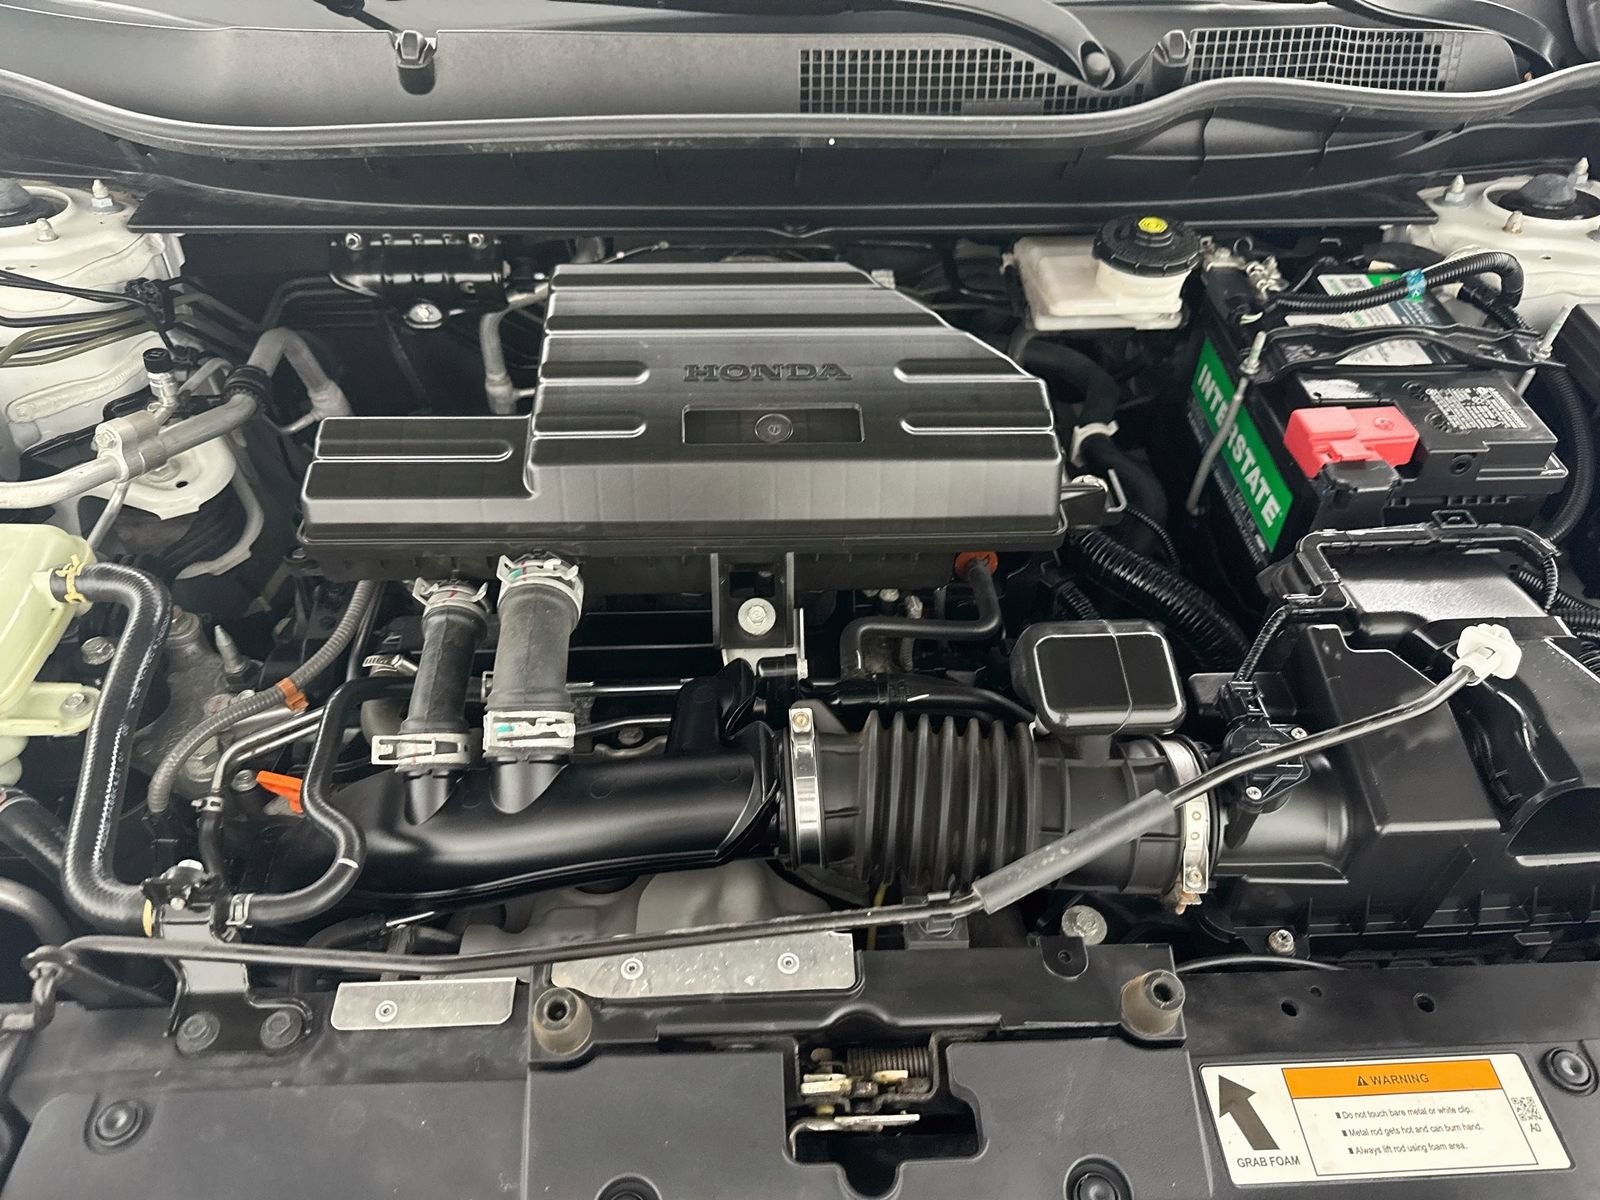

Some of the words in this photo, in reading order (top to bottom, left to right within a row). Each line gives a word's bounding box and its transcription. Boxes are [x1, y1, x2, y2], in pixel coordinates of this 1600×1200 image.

[684, 363, 852, 382] HONDA
[1197, 365, 1281, 528] INTERSTATE
[1370, 1073, 1429, 1085] WARNING
[1342, 1111, 1353, 1119] Do
[1367, 1110, 1388, 1118] touch
[1390, 1108, 1406, 1117] bare
[1407, 1108, 1427, 1116] metal
[1437, 1106, 1456, 1114] white
[1349, 1128, 1369, 1137] Metal
[1371, 1128, 1382, 1136] rod
[1384, 1126, 1400, 1137] gets
[1402, 1126, 1413, 1134] hot
[1415, 1125, 1428, 1133] and
[1445, 1124, 1461, 1132] burn
[1462, 1122, 1483, 1131] hand.
[1356, 1146, 1382, 1156] Always
[1383, 1145, 1391, 1153] lift
[1394, 1144, 1406, 1152] rod
[1407, 1143, 1427, 1153] using
[1428, 1142, 1446, 1151] foam
[1449, 1142, 1468, 1150] area.
[1237, 1156, 1268, 1168] GRAB
[1269, 1155, 1300, 1167] FOAM
